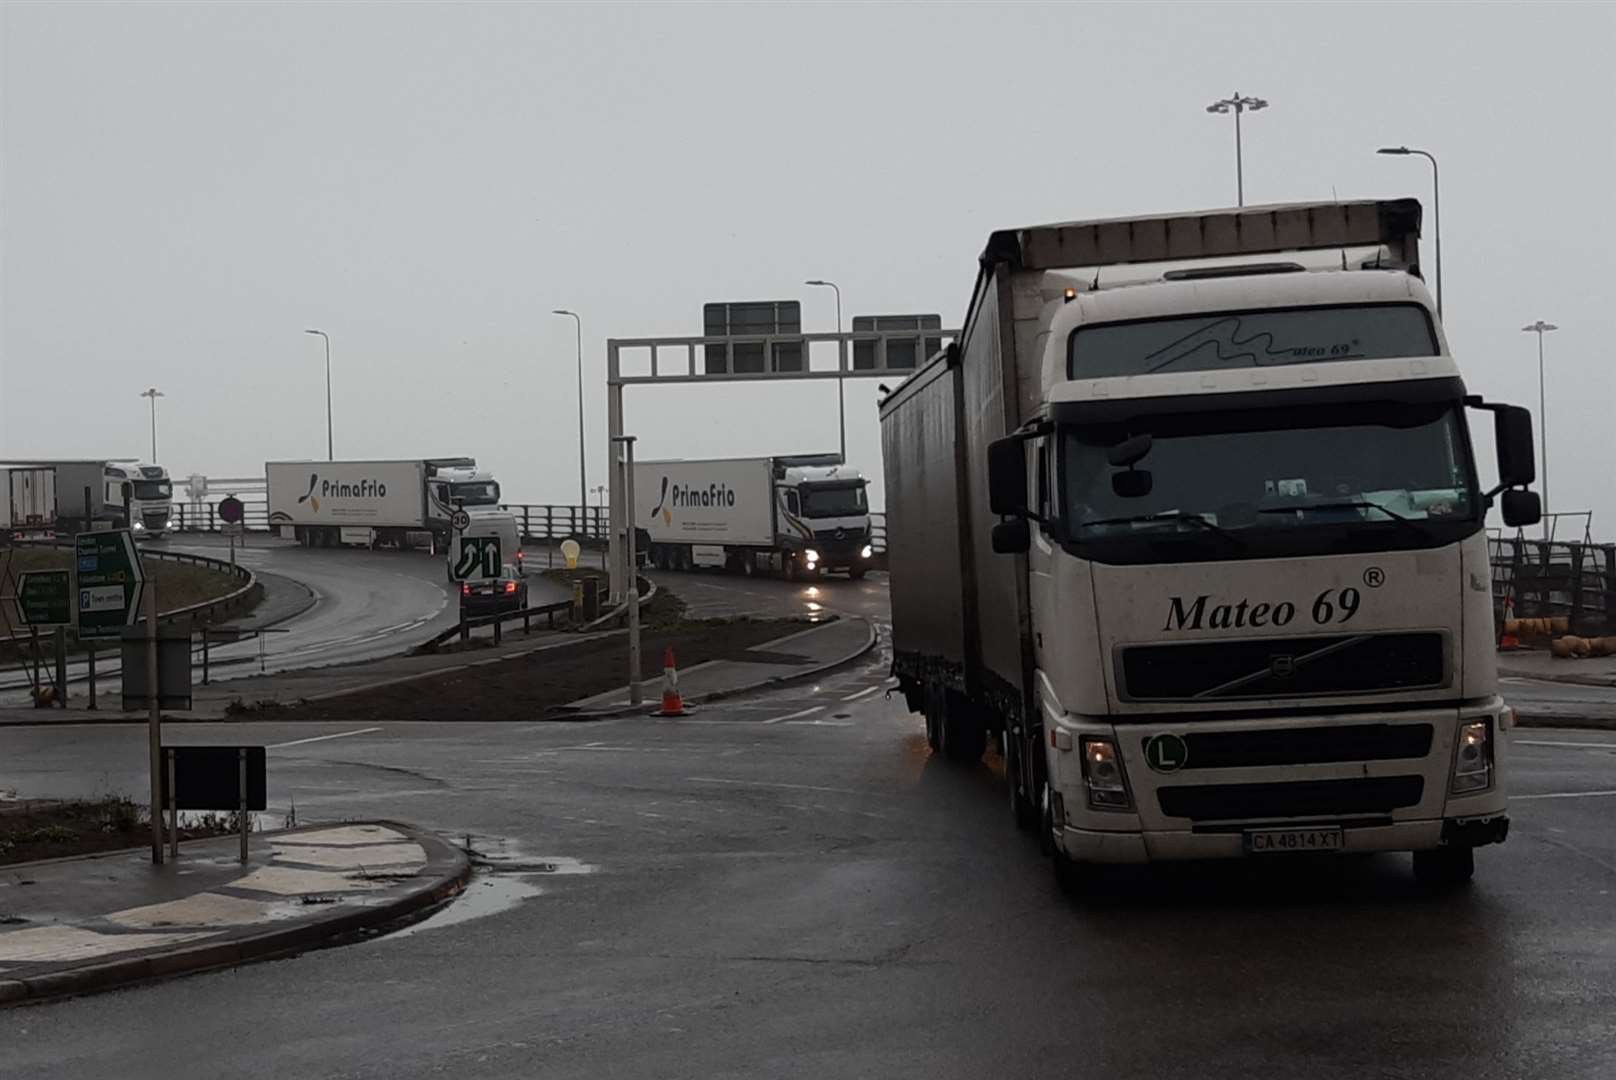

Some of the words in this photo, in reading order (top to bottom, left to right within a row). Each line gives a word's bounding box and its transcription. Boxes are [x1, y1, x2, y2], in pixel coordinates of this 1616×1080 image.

[322, 479, 386, 497] PrimaFrio
[673, 483, 735, 507] PrimaFrio
[454, 515, 467, 525] 30
[1163, 595, 1295, 631] Mateo
[1158, 740, 1176, 766] L
[1254, 834, 1275, 849] CA
[1278, 832, 1316, 849] 4814
[1319, 831, 1339, 848] XT
